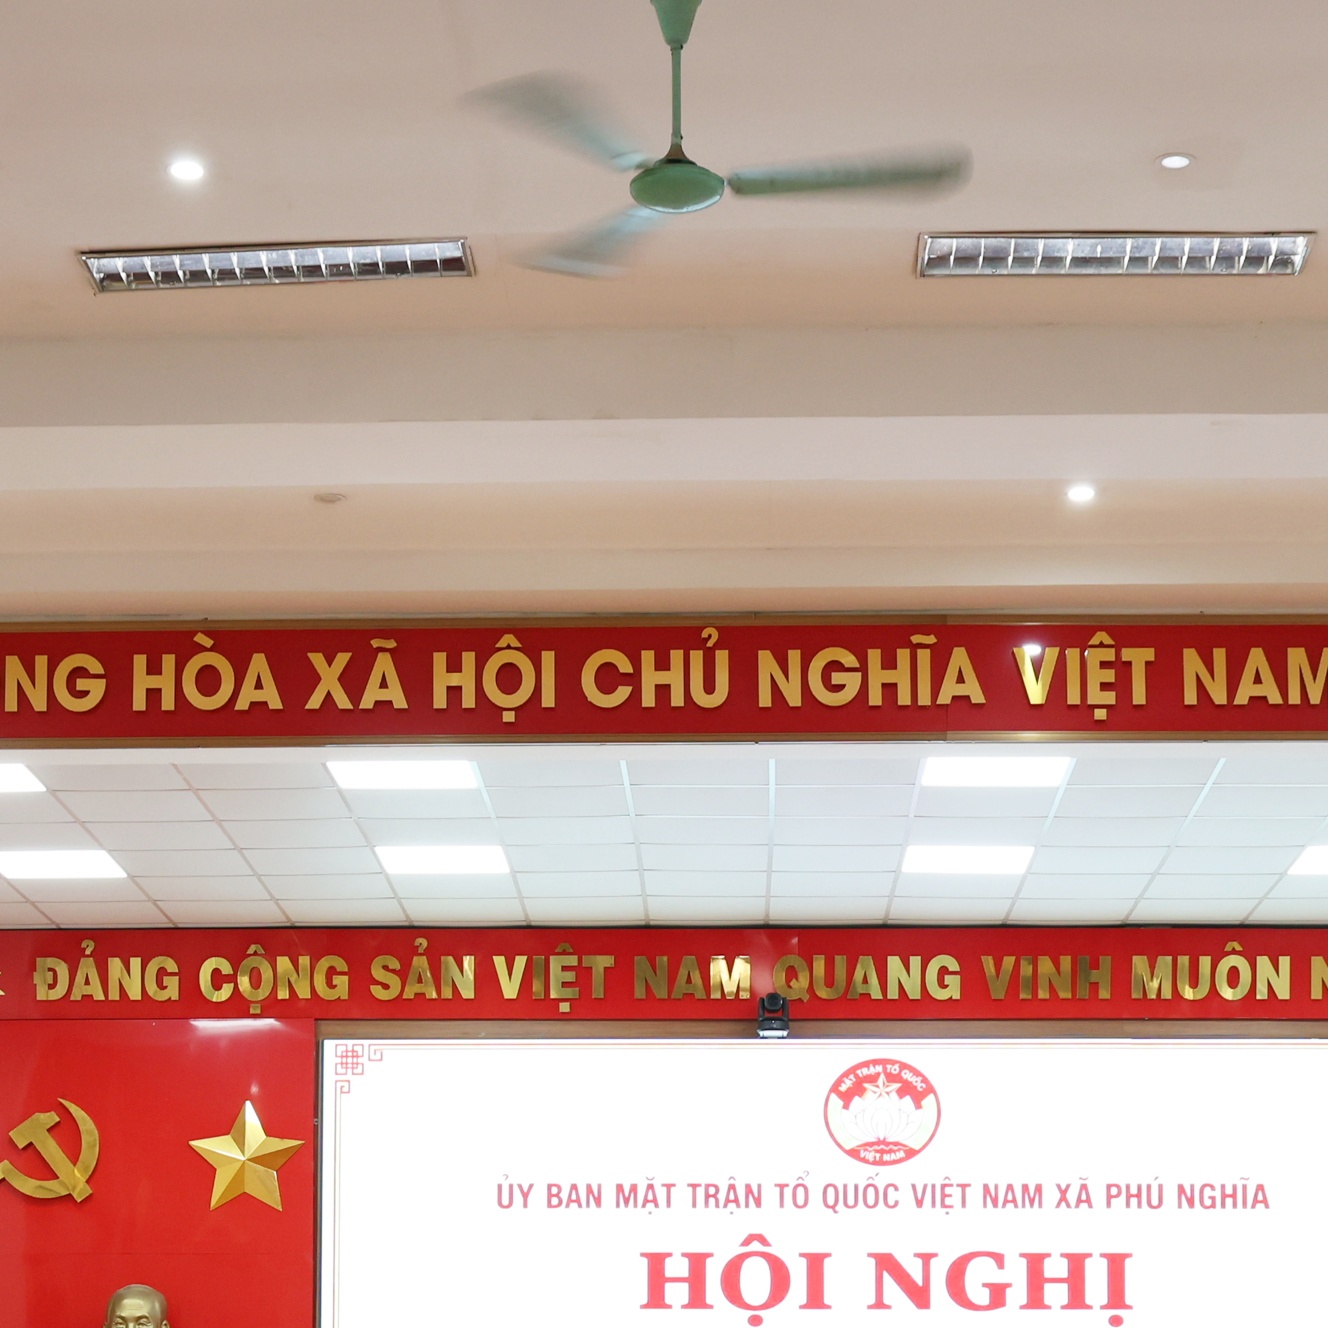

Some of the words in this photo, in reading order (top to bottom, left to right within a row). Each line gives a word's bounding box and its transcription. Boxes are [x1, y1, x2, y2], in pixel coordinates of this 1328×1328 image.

[133, 633, 283, 710] HÒA
[305, 639, 408, 709] XÃ
[433, 635, 555, 722] HỘI
[582, 627, 728, 708] CHỦ
[758, 635, 985, 706] NGHĨA
[1012, 632, 1154, 720] VIỆT
[34, 940, 179, 1001] ĐẢNG
[199, 945, 348, 1013] CỘNG
[370, 938, 474, 1000] SẢN
[493, 945, 614, 1012] VIỆT
[636, 956, 751, 999] NAM
[771, 955, 960, 1004] QUANG
[982, 956, 1110, 999] VINH
[1132, 942, 1290, 1000] MUÔN
[838, 1073, 856, 1093] MẶT
[856, 1064, 883, 1077] TRẬN
[901, 1069, 927, 1092] QUỐC
[859, 1150, 881, 1163] VIỆT
[883, 1150, 906, 1162] NAM
[497, 1174, 534, 1209] ỦY
[547, 1183, 602, 1209] BAN
[616, 1177, 676, 1214] MẶT
[687, 1176, 762, 1214] TRẬN
[774, 1171, 809, 1209] TỔ
[822, 1173, 899, 1214] QUỐC
[911, 1176, 971, 1215] VIỆT
[983, 1183, 1043, 1209] NAM
[1055, 1177, 1093, 1209] XÃ
[1106, 1177, 1163, 1209] PHÚ
[1177, 1177, 1270, 1209] NGHĨA
[640, 1233, 832, 1327] HỘI
[867, 1251, 1133, 1327] NGHỊ
